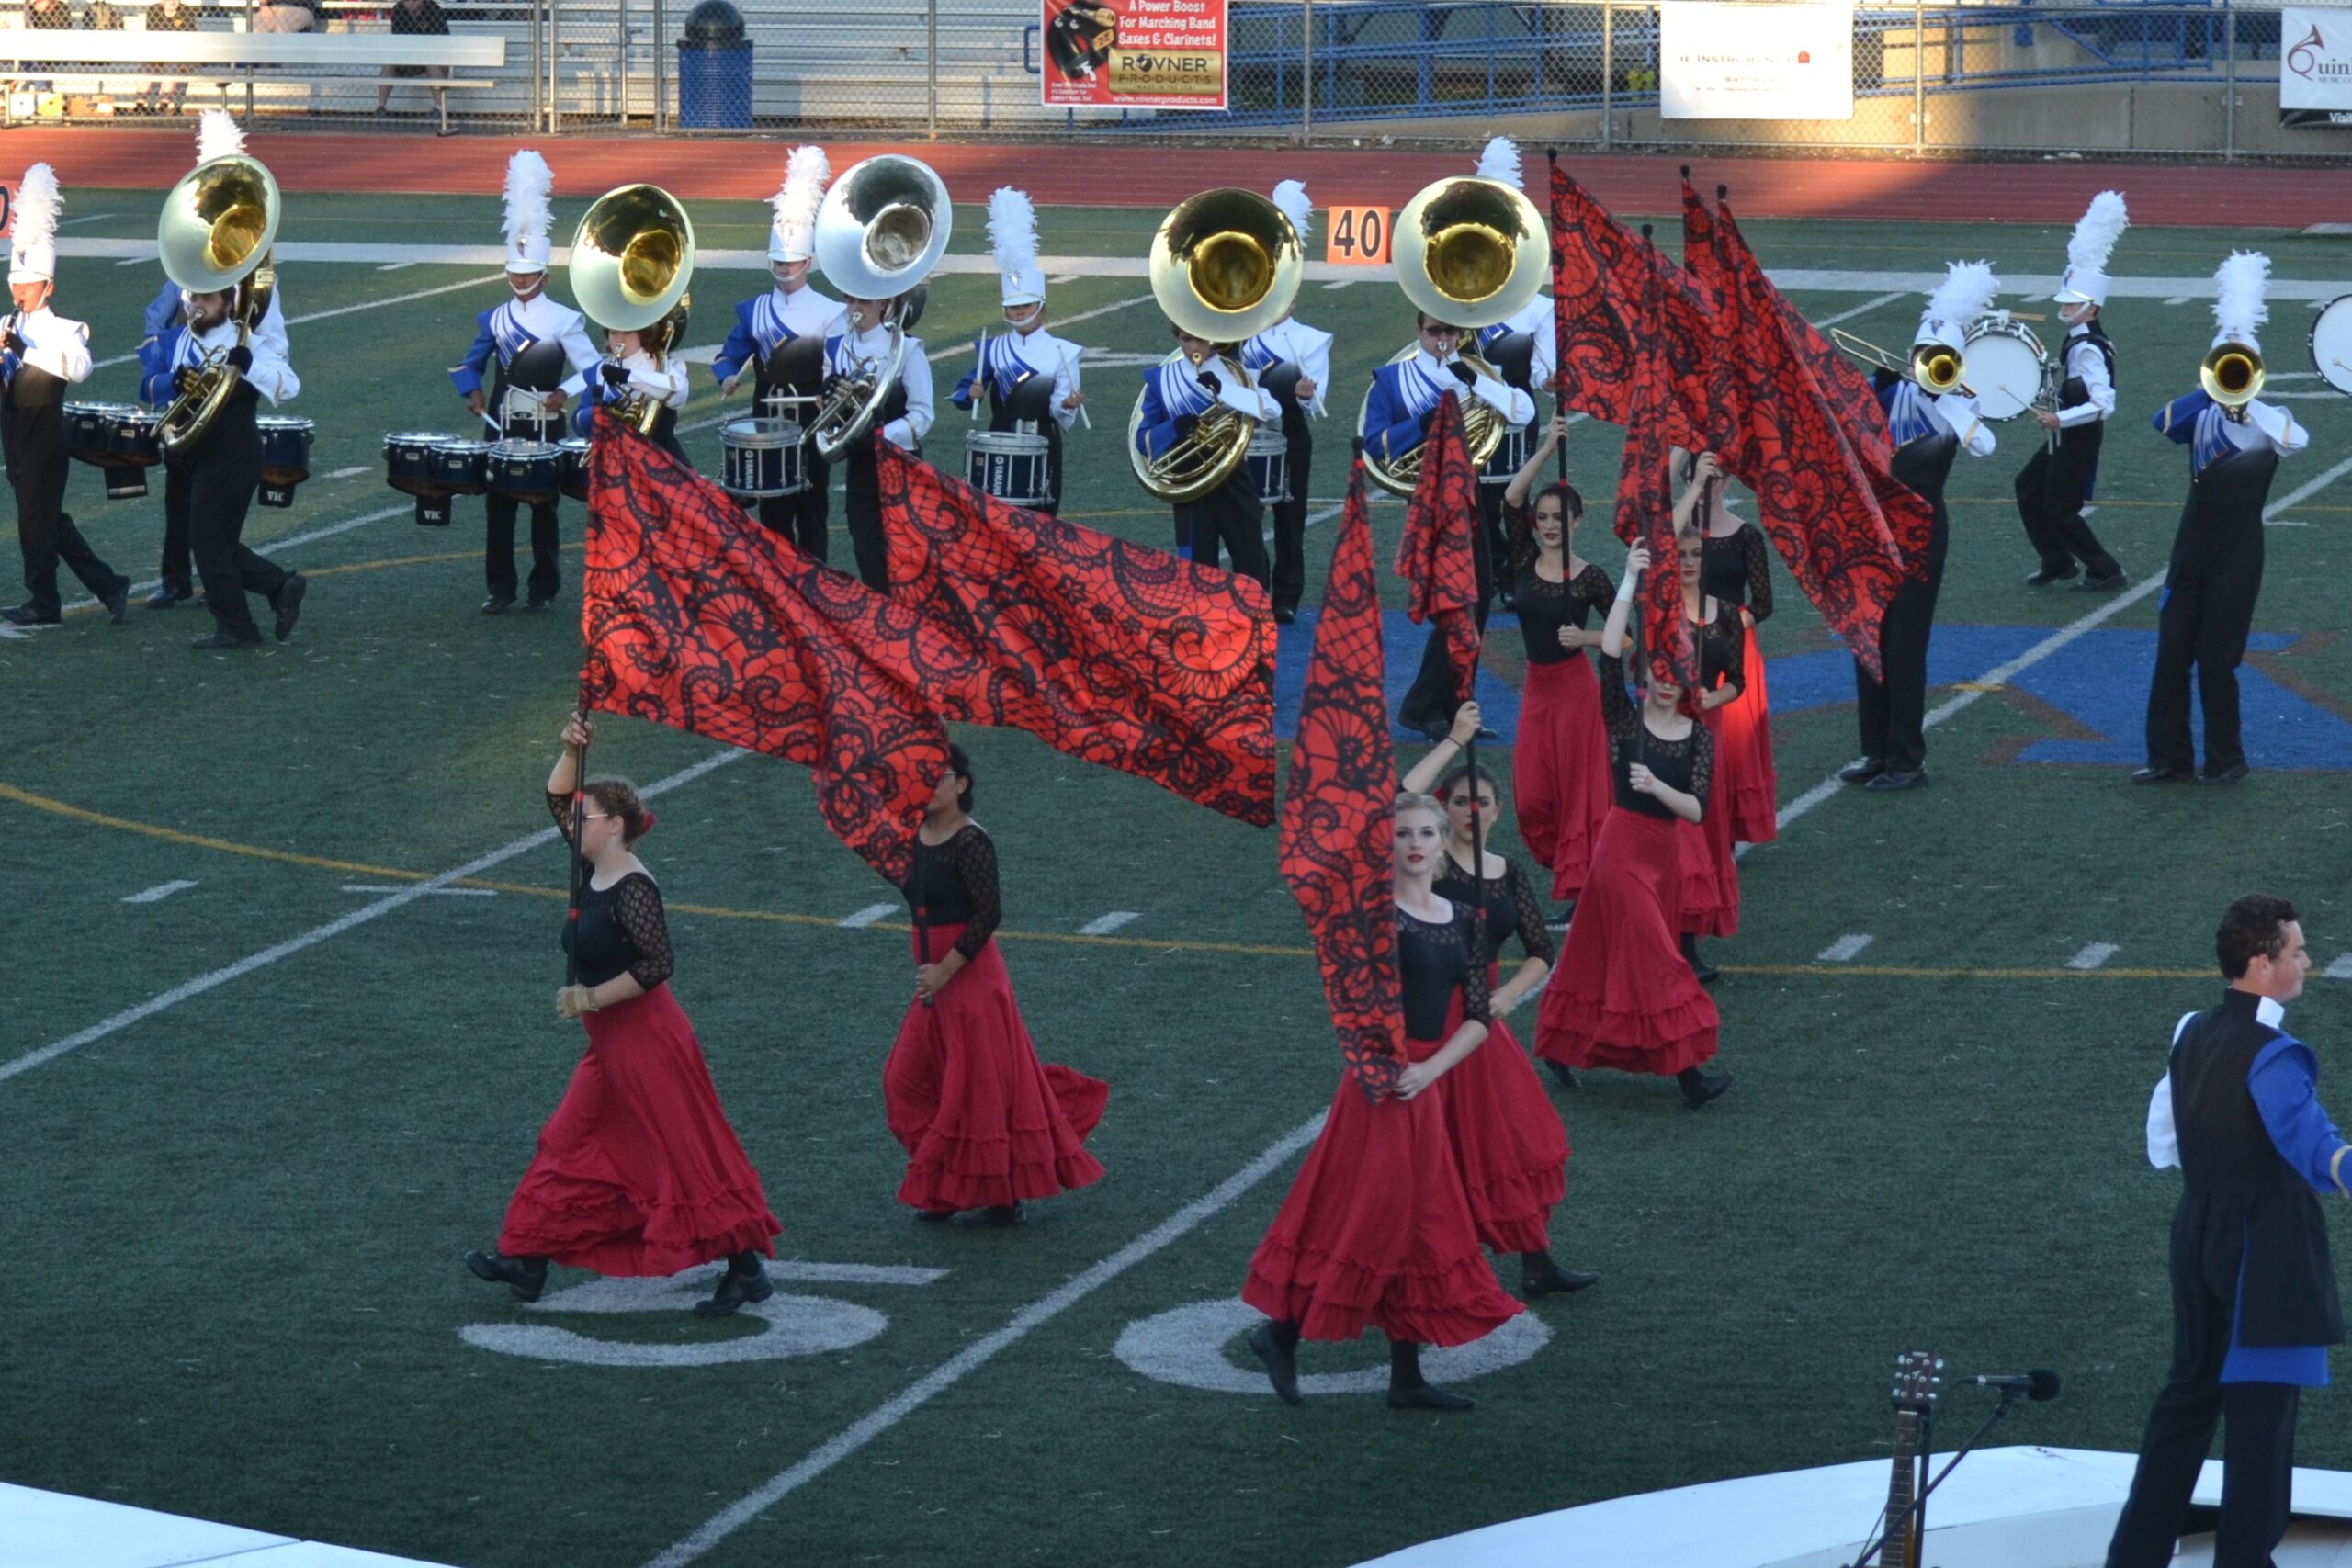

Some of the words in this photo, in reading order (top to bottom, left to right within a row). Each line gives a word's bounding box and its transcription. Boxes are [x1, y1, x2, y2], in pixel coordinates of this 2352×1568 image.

[1129, 0, 1137, 12] A
[1138, 0, 1171, 13] Power
[1173, 0, 1206, 13] Boost
[1118, 16, 1137, 28] For
[1138, 16, 1187, 30] Marching
[1189, 17, 1216, 29] Band
[1118, 31, 1150, 45] Saxes
[1152, 32, 1161, 45] &
[1163, 32, 1217, 46] Clarinets!
[1121, 53, 1208, 72] ROVNER
[1114, 95, 1217, 105] www.rovnerproducts.com
[1333, 209, 1382, 258] 40
[745, 459, 754, 489] YAMAHA
[993, 466, 1003, 495] YAMAHA
[266, 491, 285, 502] VIC
[423, 510, 441, 520] VIC
